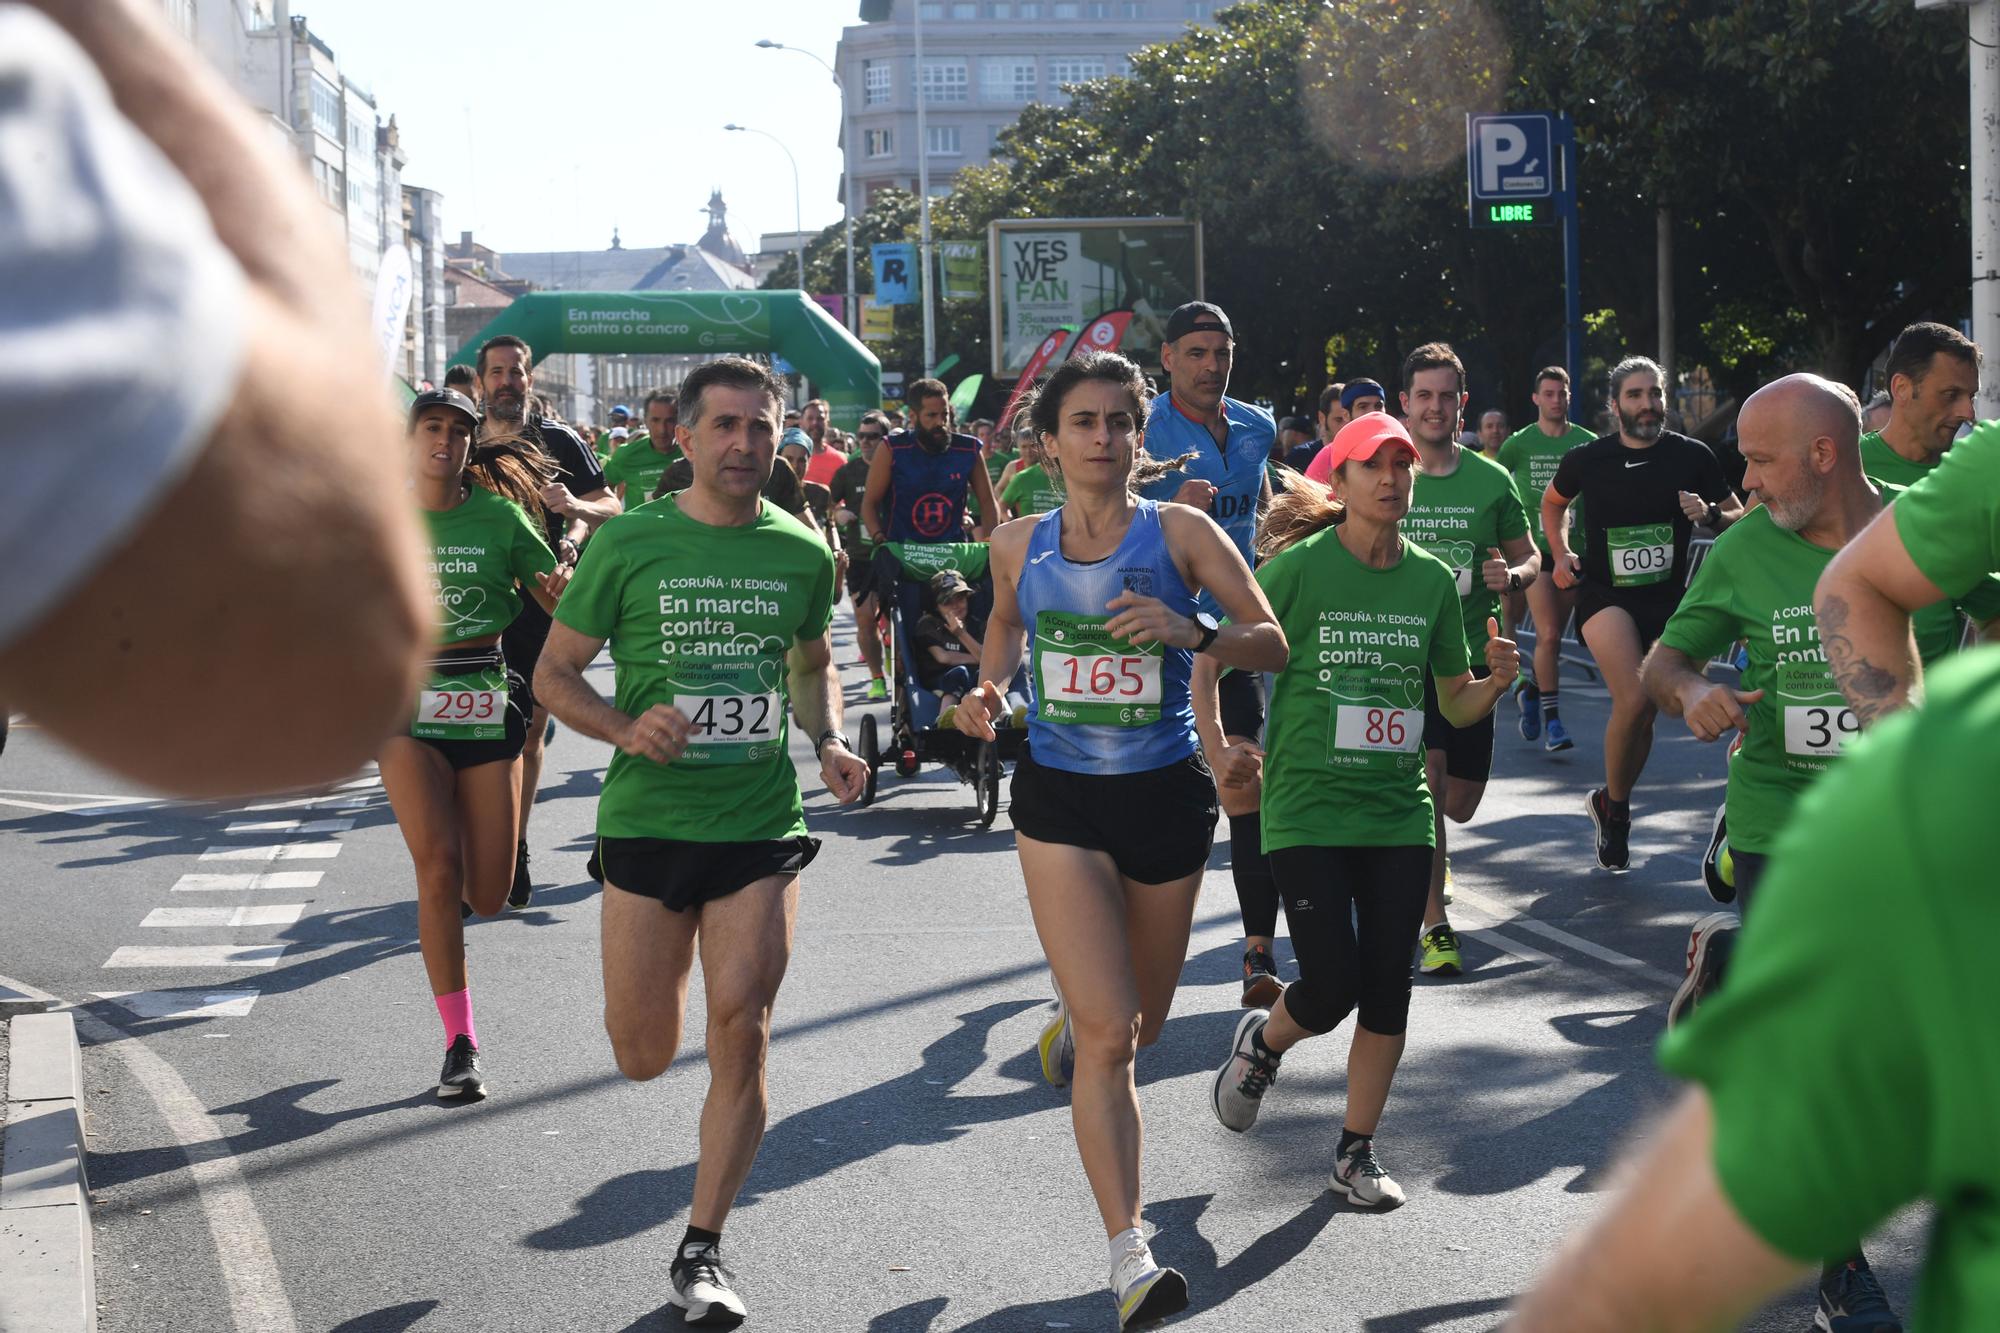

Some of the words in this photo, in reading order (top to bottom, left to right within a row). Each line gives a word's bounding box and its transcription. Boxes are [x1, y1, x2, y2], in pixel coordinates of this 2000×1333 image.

[1480, 123, 1527, 191] P
[1491, 205, 1533, 222] LIBRE
[1014, 240, 1068, 262] YES
[1014, 261, 1057, 282] WE
[1016, 280, 1068, 301] FAN
[568, 308, 588, 321] En
[591, 308, 650, 321] marcha
[569, 323, 620, 335] contra
[622, 324, 633, 335] o
[635, 324, 689, 335] cancro
[922, 502, 944, 525] H
[1209, 494, 1250, 518] ADA
[1408, 505, 1430, 513] RUÑA
[1396, 518, 1407, 527] n
[1412, 517, 1468, 528] marcha
[1400, 530, 1437, 541] ontra
[438, 546, 446, 554] IX
[448, 546, 485, 555] EDICIÓN
[1623, 547, 1666, 570] 603
[428, 558, 478, 573] archa
[658, 580, 667, 590] A
[670, 576, 724, 588] CORUÑA
[731, 578, 742, 588] IX
[744, 579, 787, 592] EDICIÓN
[660, 595, 688, 614] En
[696, 596, 780, 616] marcha
[1773, 610, 1780, 620] A
[1782, 606, 1815, 618] CORU
[660, 617, 735, 636] contra
[1319, 612, 1326, 620] A
[1328, 610, 1372, 622] CORUÑA
[1378, 614, 1387, 623] IX
[1388, 614, 1426, 626] EDICIÓN
[1320, 626, 1344, 644] En
[1349, 629, 1420, 648] marcha
[1772, 624, 1800, 644] En
[662, 640, 676, 654] o
[1778, 644, 1829, 662] cont
[724, 660, 754, 670] marcha
[1318, 648, 1382, 665] contra
[1062, 656, 1144, 696] 165
[1318, 669, 1332, 682] o
[1380, 678, 1402, 686] marcha
[433, 692, 494, 719] 293
[1060, 710, 1076, 718] Maio
[691, 696, 770, 735] 432
[1366, 709, 1405, 745] 86
[1806, 708, 1862, 748] 39
[692, 752, 710, 760] Maio
